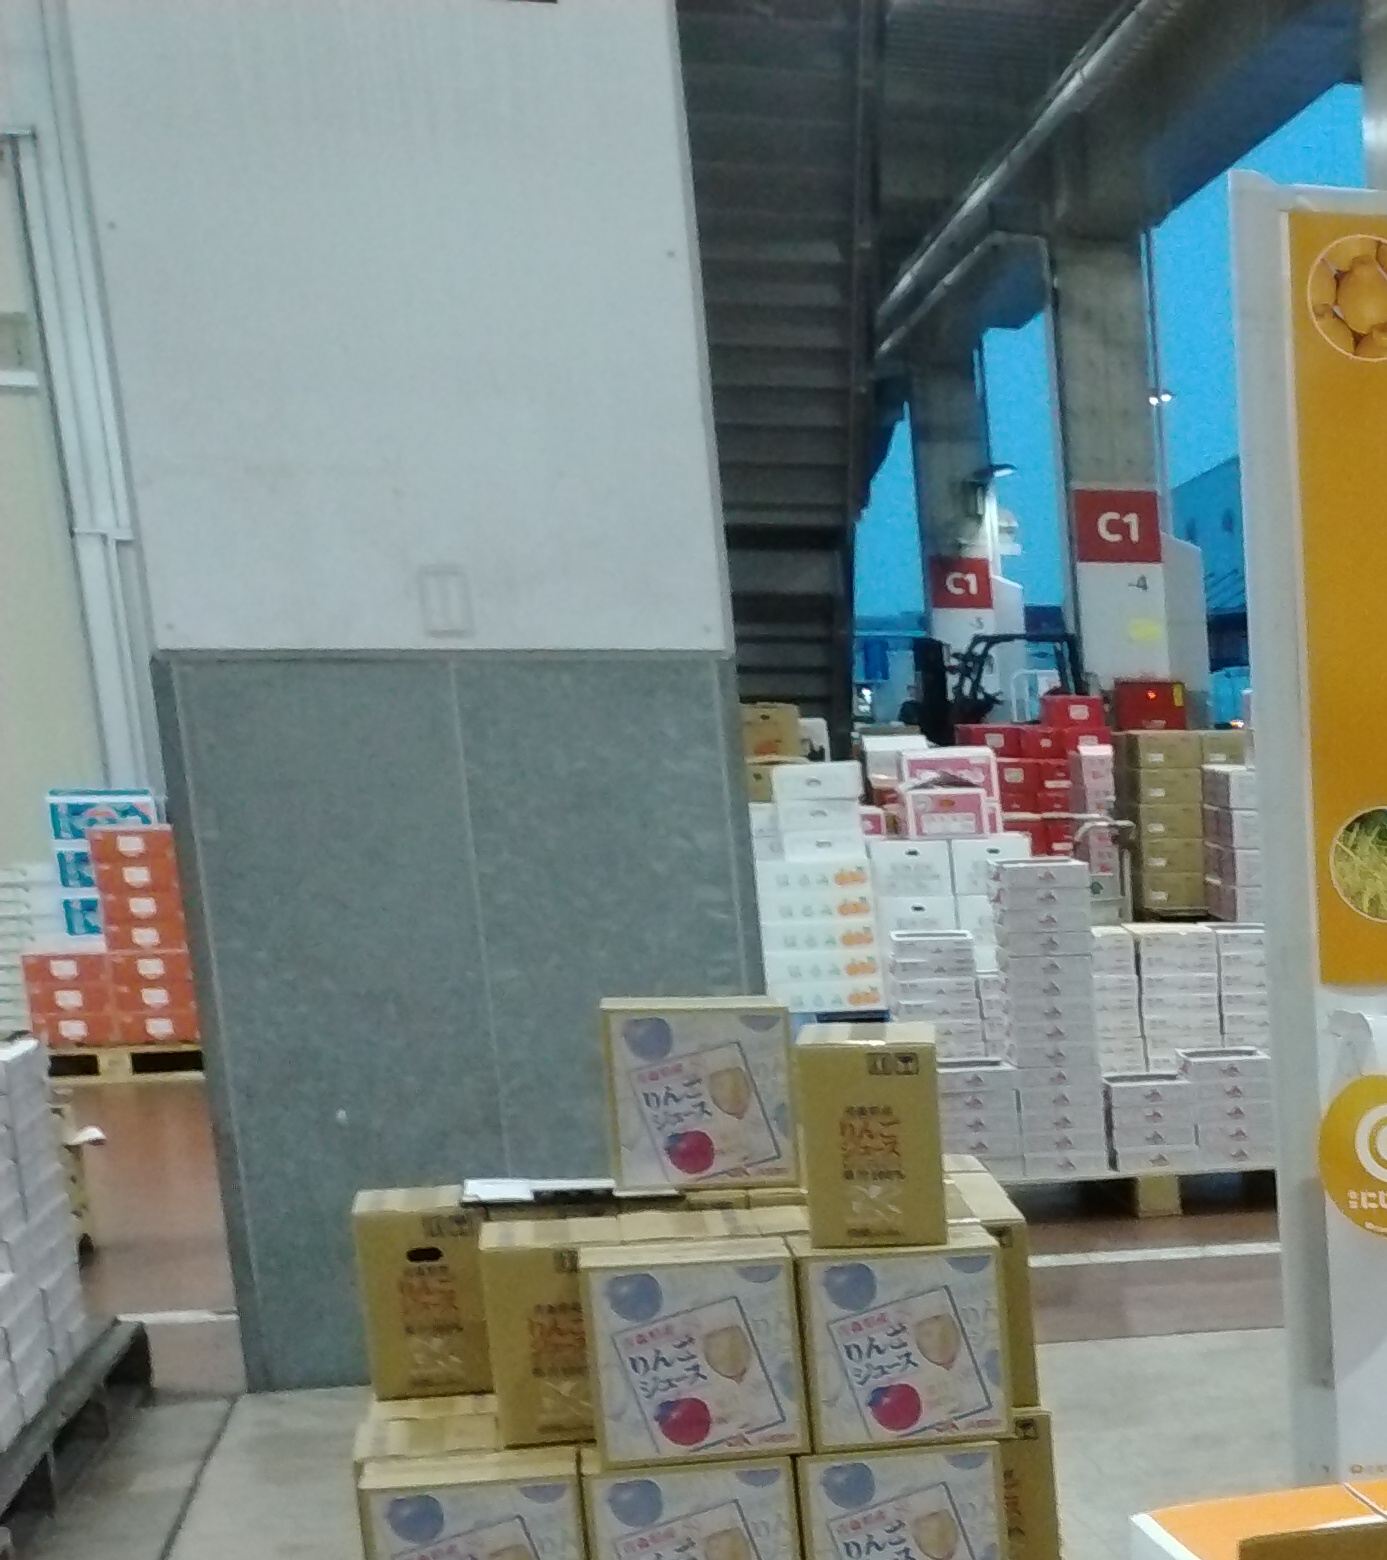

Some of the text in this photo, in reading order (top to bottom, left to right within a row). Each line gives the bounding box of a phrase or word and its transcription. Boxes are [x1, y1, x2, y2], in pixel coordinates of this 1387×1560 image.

[1097, 511, 1142, 545] C1
[945, 571, 978, 596] C1
[629, 1338, 699, 1375] りんご
[843, 1324, 910, 1364] りんご
[843, 1520, 906, 1560] りんご
